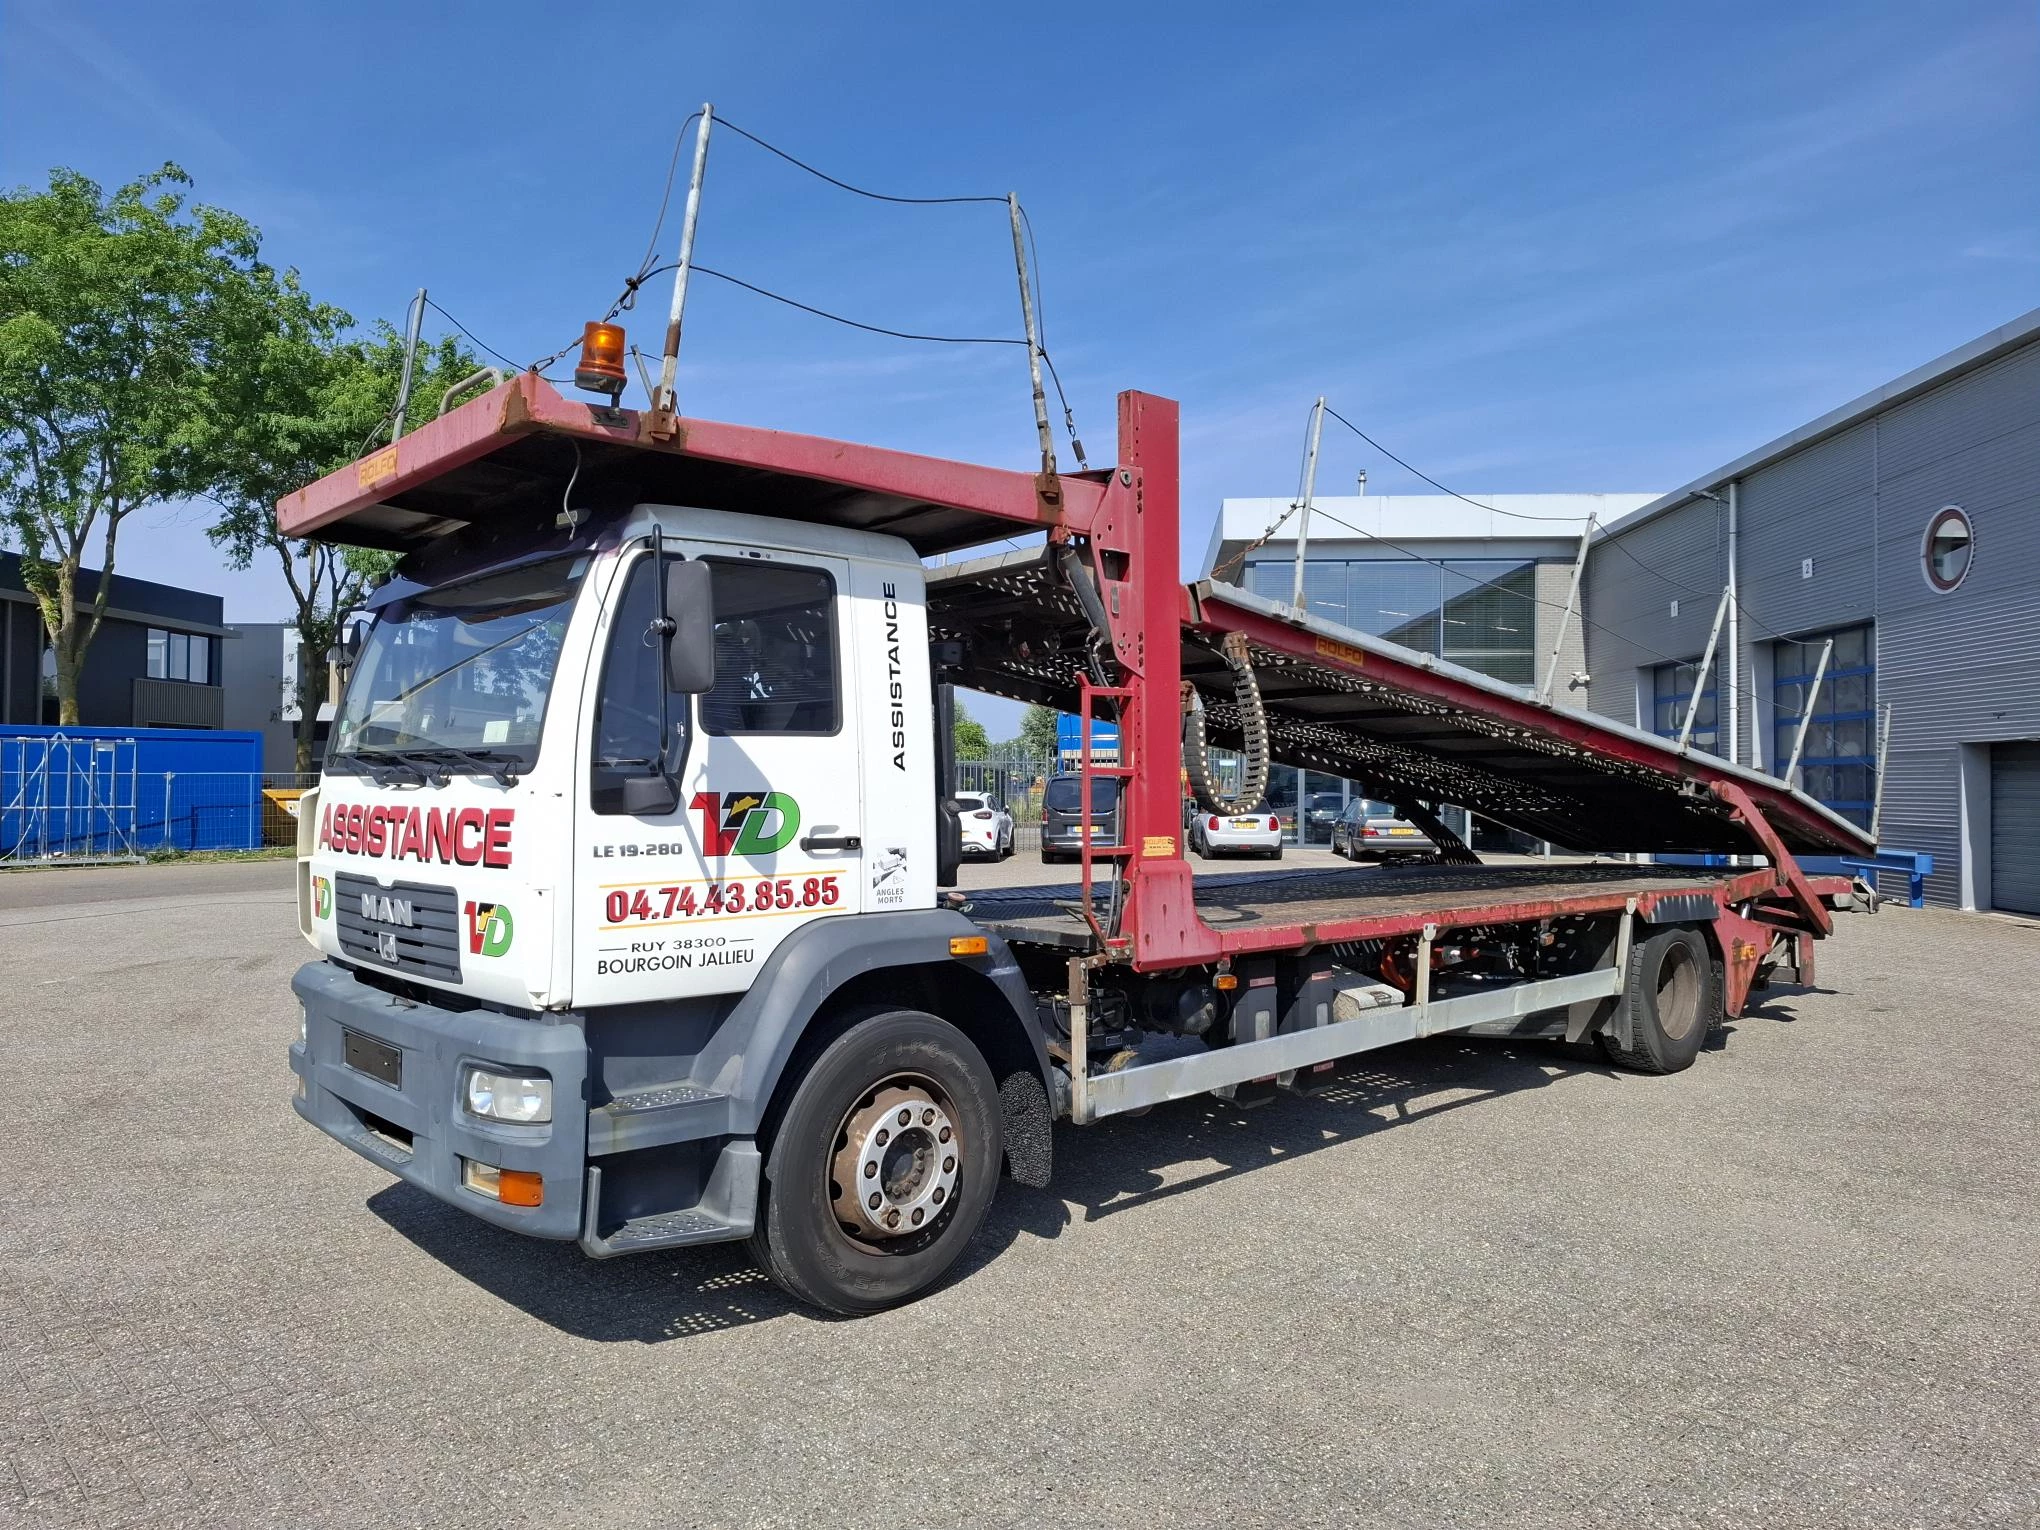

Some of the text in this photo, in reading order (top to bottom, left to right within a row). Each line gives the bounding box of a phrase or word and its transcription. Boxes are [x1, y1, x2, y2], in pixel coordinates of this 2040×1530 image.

[883, 582, 906, 772] ASSISTANCE
[319, 803, 515, 869] ASSISTANCE
[593, 845, 615, 858] LE
[606, 876, 839, 922] 04.74.43.85.85
[876, 887, 905, 897] ANGLES
[877, 896, 903, 905] MORTS
[361, 893, 414, 927] MAN
[631, 937, 726, 953] RUY 38300
[597, 949, 755, 975] BOURGOIN JALLIEU
